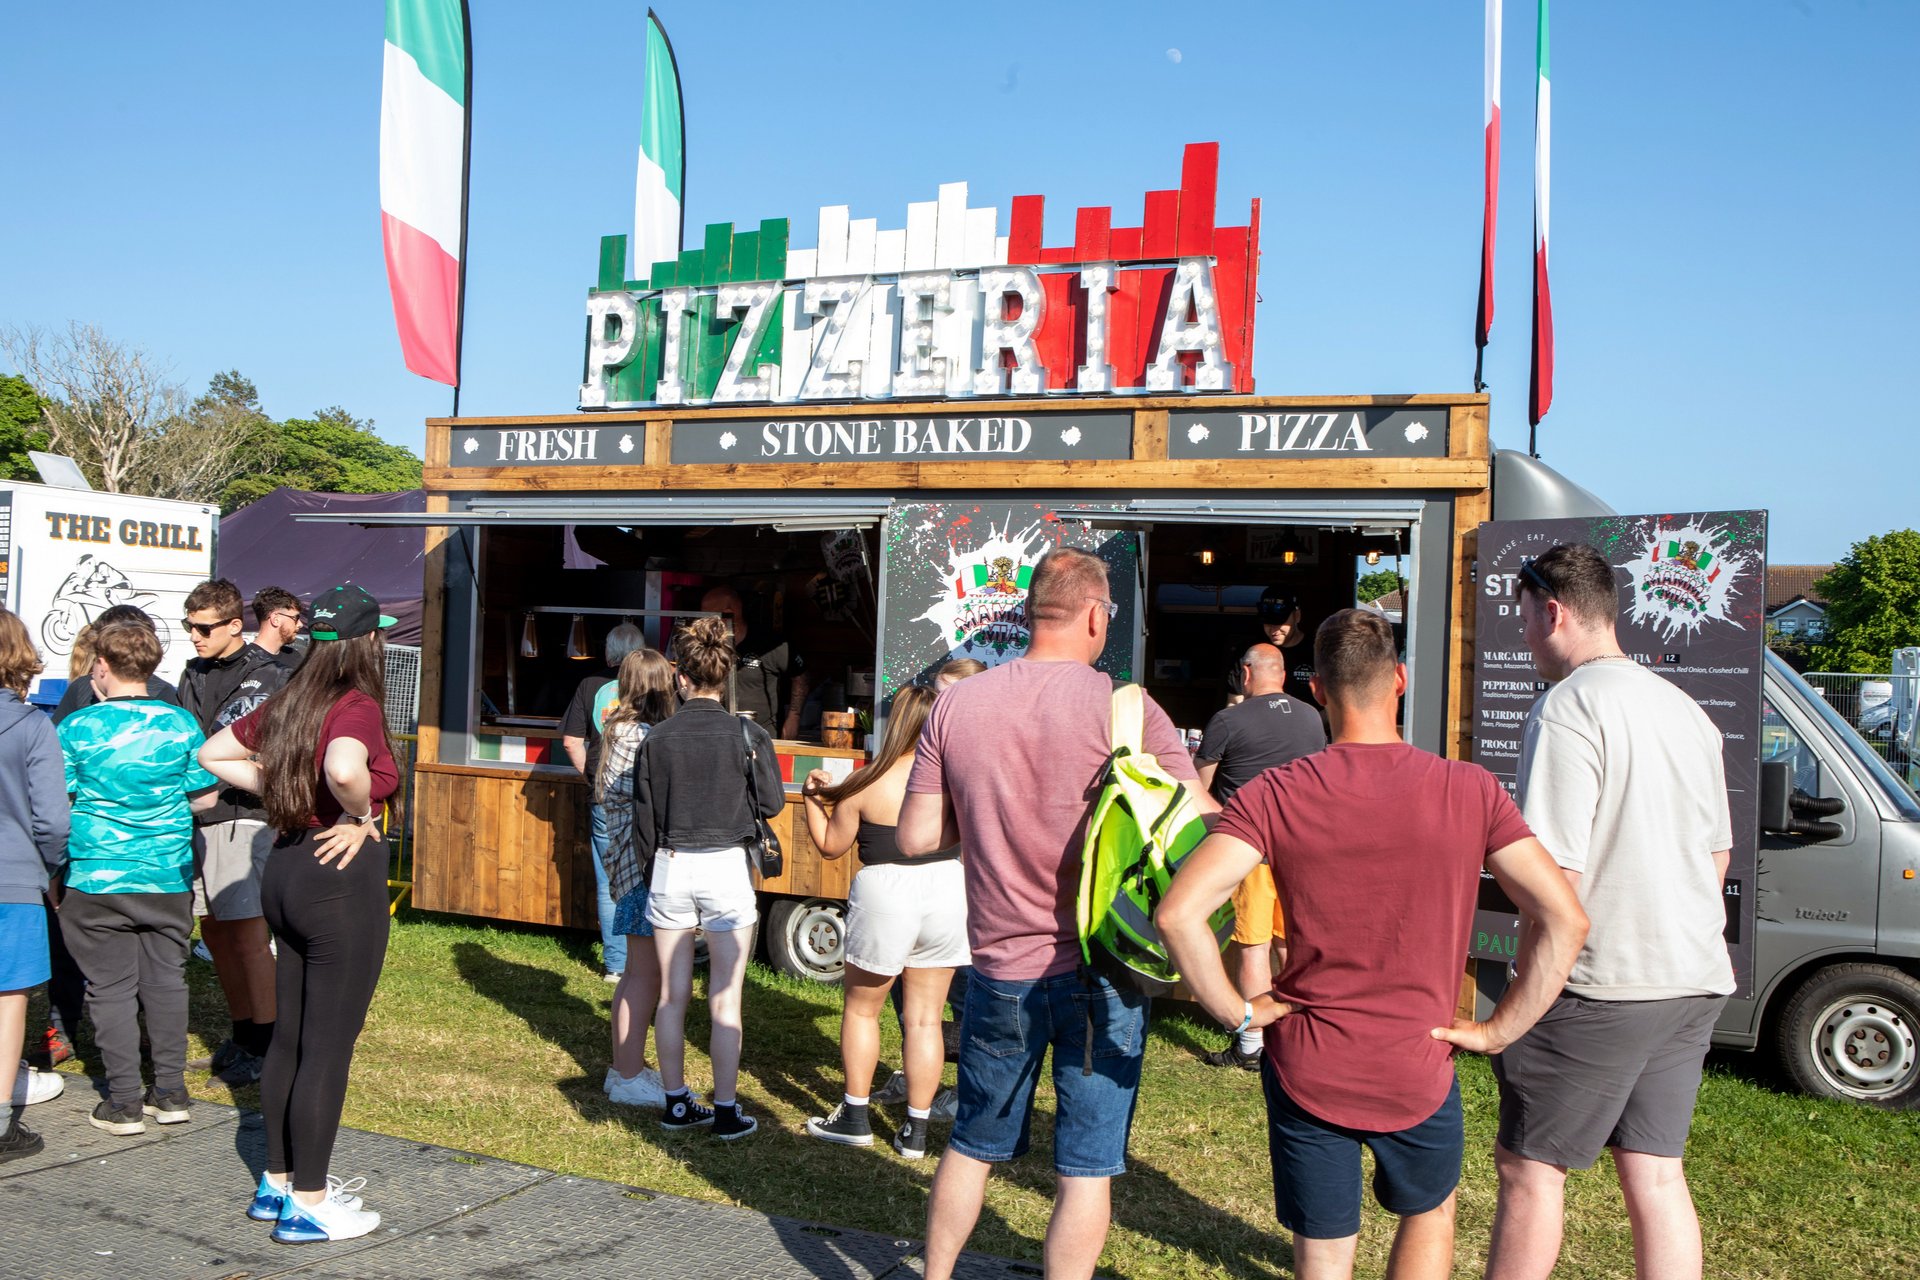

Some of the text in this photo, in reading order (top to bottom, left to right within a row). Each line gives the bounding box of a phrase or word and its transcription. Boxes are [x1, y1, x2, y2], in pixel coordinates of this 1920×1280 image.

[580, 255, 1236, 408] PIZZERIA
[496, 412, 1373, 462] FRESH STONE BAKED PIZZA
[45, 511, 111, 543] THE
[118, 518, 203, 552] GRILL
[1492, 539, 1518, 567] PAUSE
[1527, 533, 1545, 541] EAT
[1483, 651, 1534, 661] MARGARIT
[1628, 653, 1676, 664] AFIA 12
[1482, 680, 1534, 691] PEPPERONI
[1709, 699, 1736, 708] Shavings
[1495, 721, 1520, 729] Pineapple
[1725, 732, 1745, 740] Sauce,
[1725, 884, 1740, 895] 11
[1477, 931, 1518, 956] PAU
